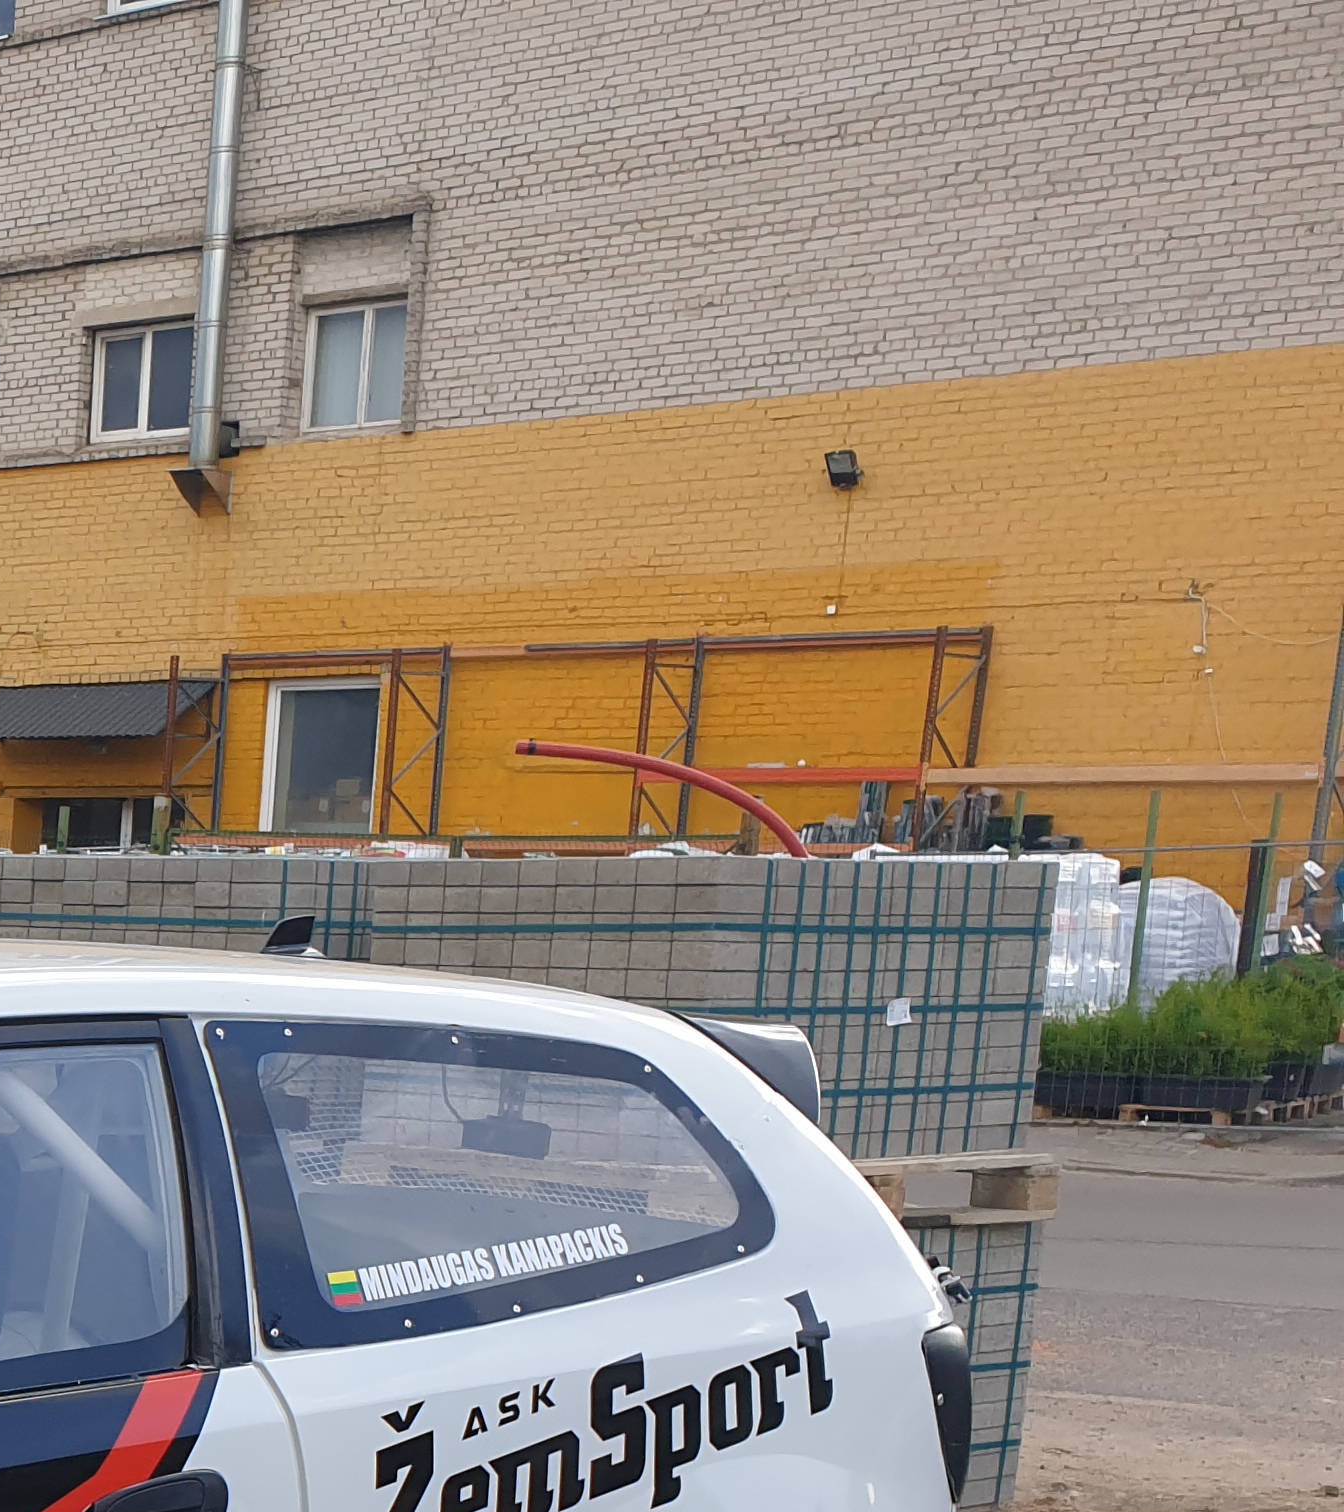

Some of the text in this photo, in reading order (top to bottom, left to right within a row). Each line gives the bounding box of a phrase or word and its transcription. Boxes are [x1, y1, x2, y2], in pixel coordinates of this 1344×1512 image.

[357, 1223, 630, 1302] MINDAUGAS KANAPACKIS
[461, 1377, 557, 1441] ASK
